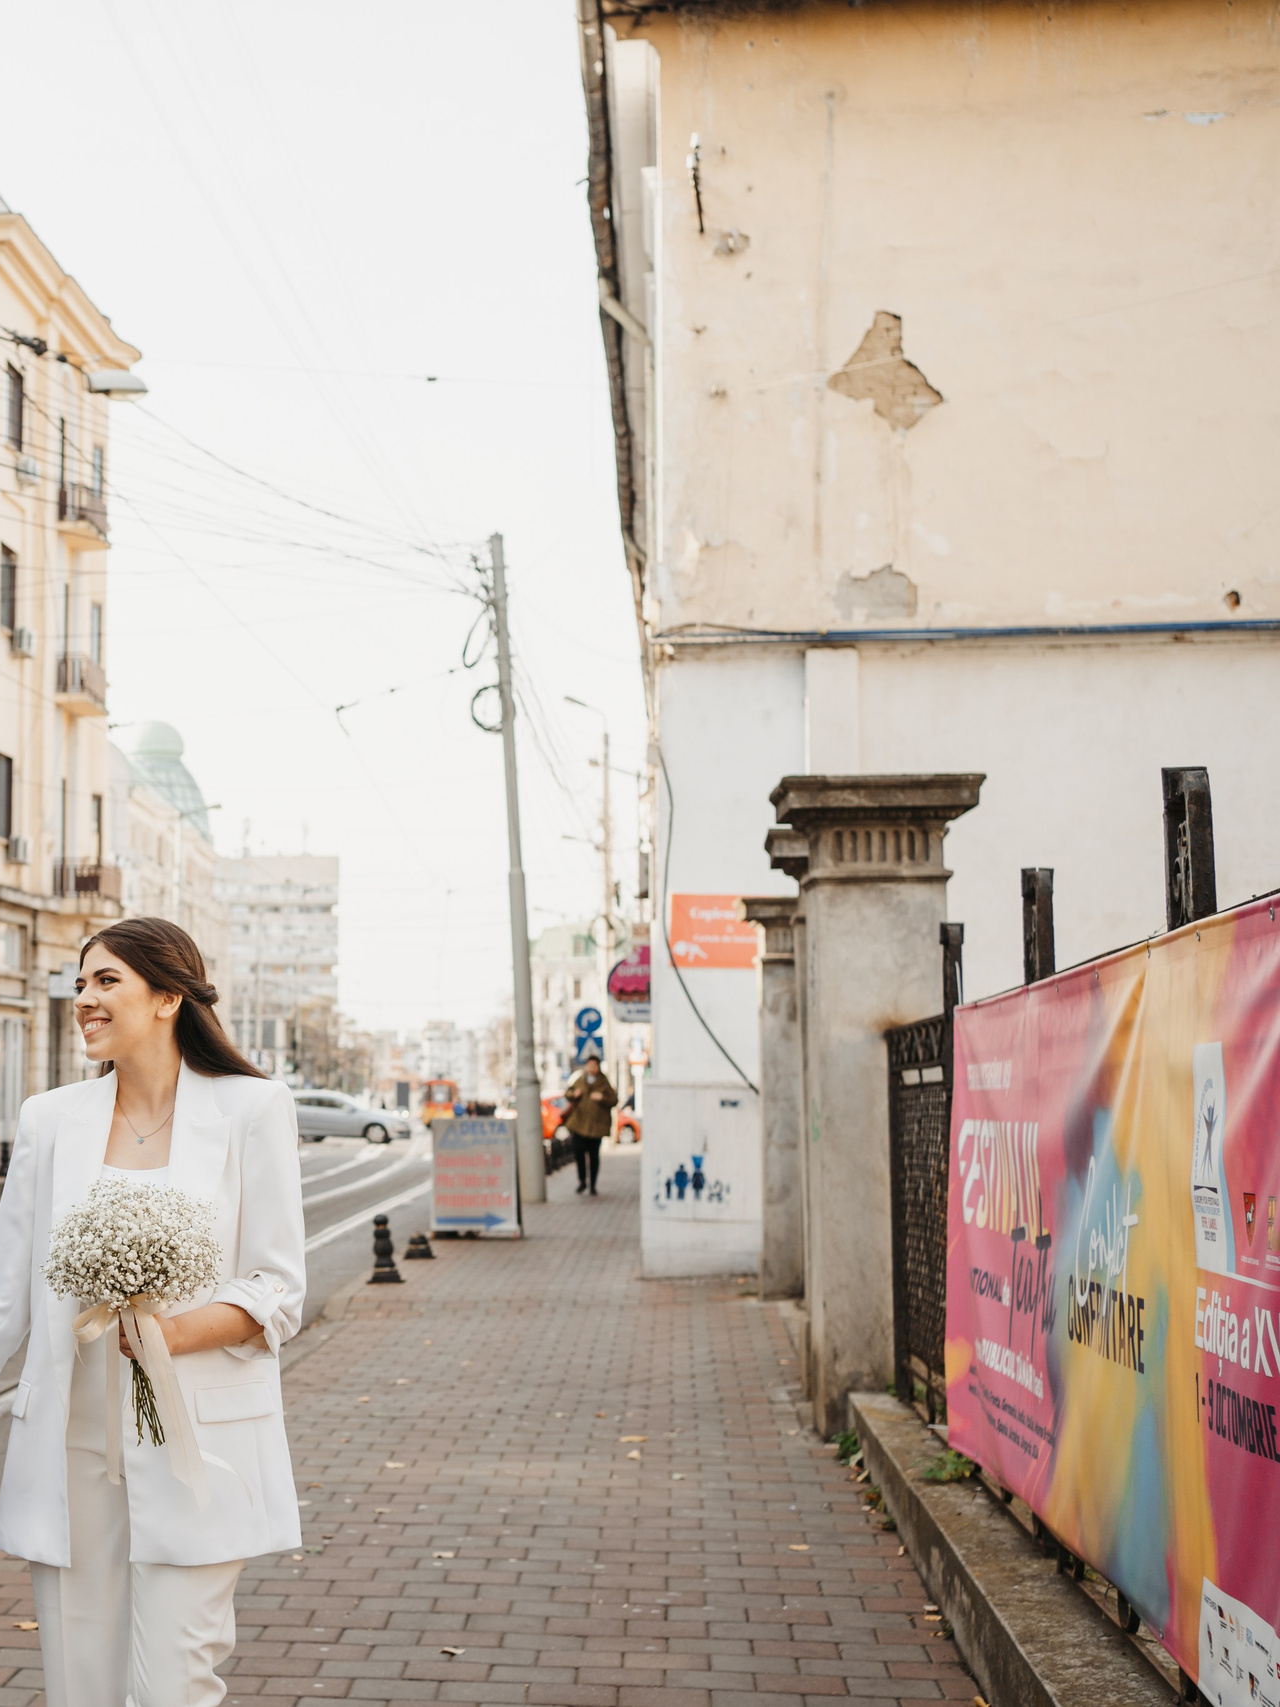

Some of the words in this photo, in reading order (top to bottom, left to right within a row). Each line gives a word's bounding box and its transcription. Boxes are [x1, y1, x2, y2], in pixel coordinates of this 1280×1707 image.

[460, 1121, 508, 1136] DELTA
[958, 1118, 1049, 1246] FESTIVALUL
[1075, 1154, 1139, 1317] Conflict
[1195, 1286, 1239, 1377] Ediția
[1240, 1317, 1250, 1369] a
[1195, 1372, 1200, 1423] 1
[1208, 1378, 1214, 1431] 9
[1215, 1382, 1280, 1464] OCTOMBRIE
